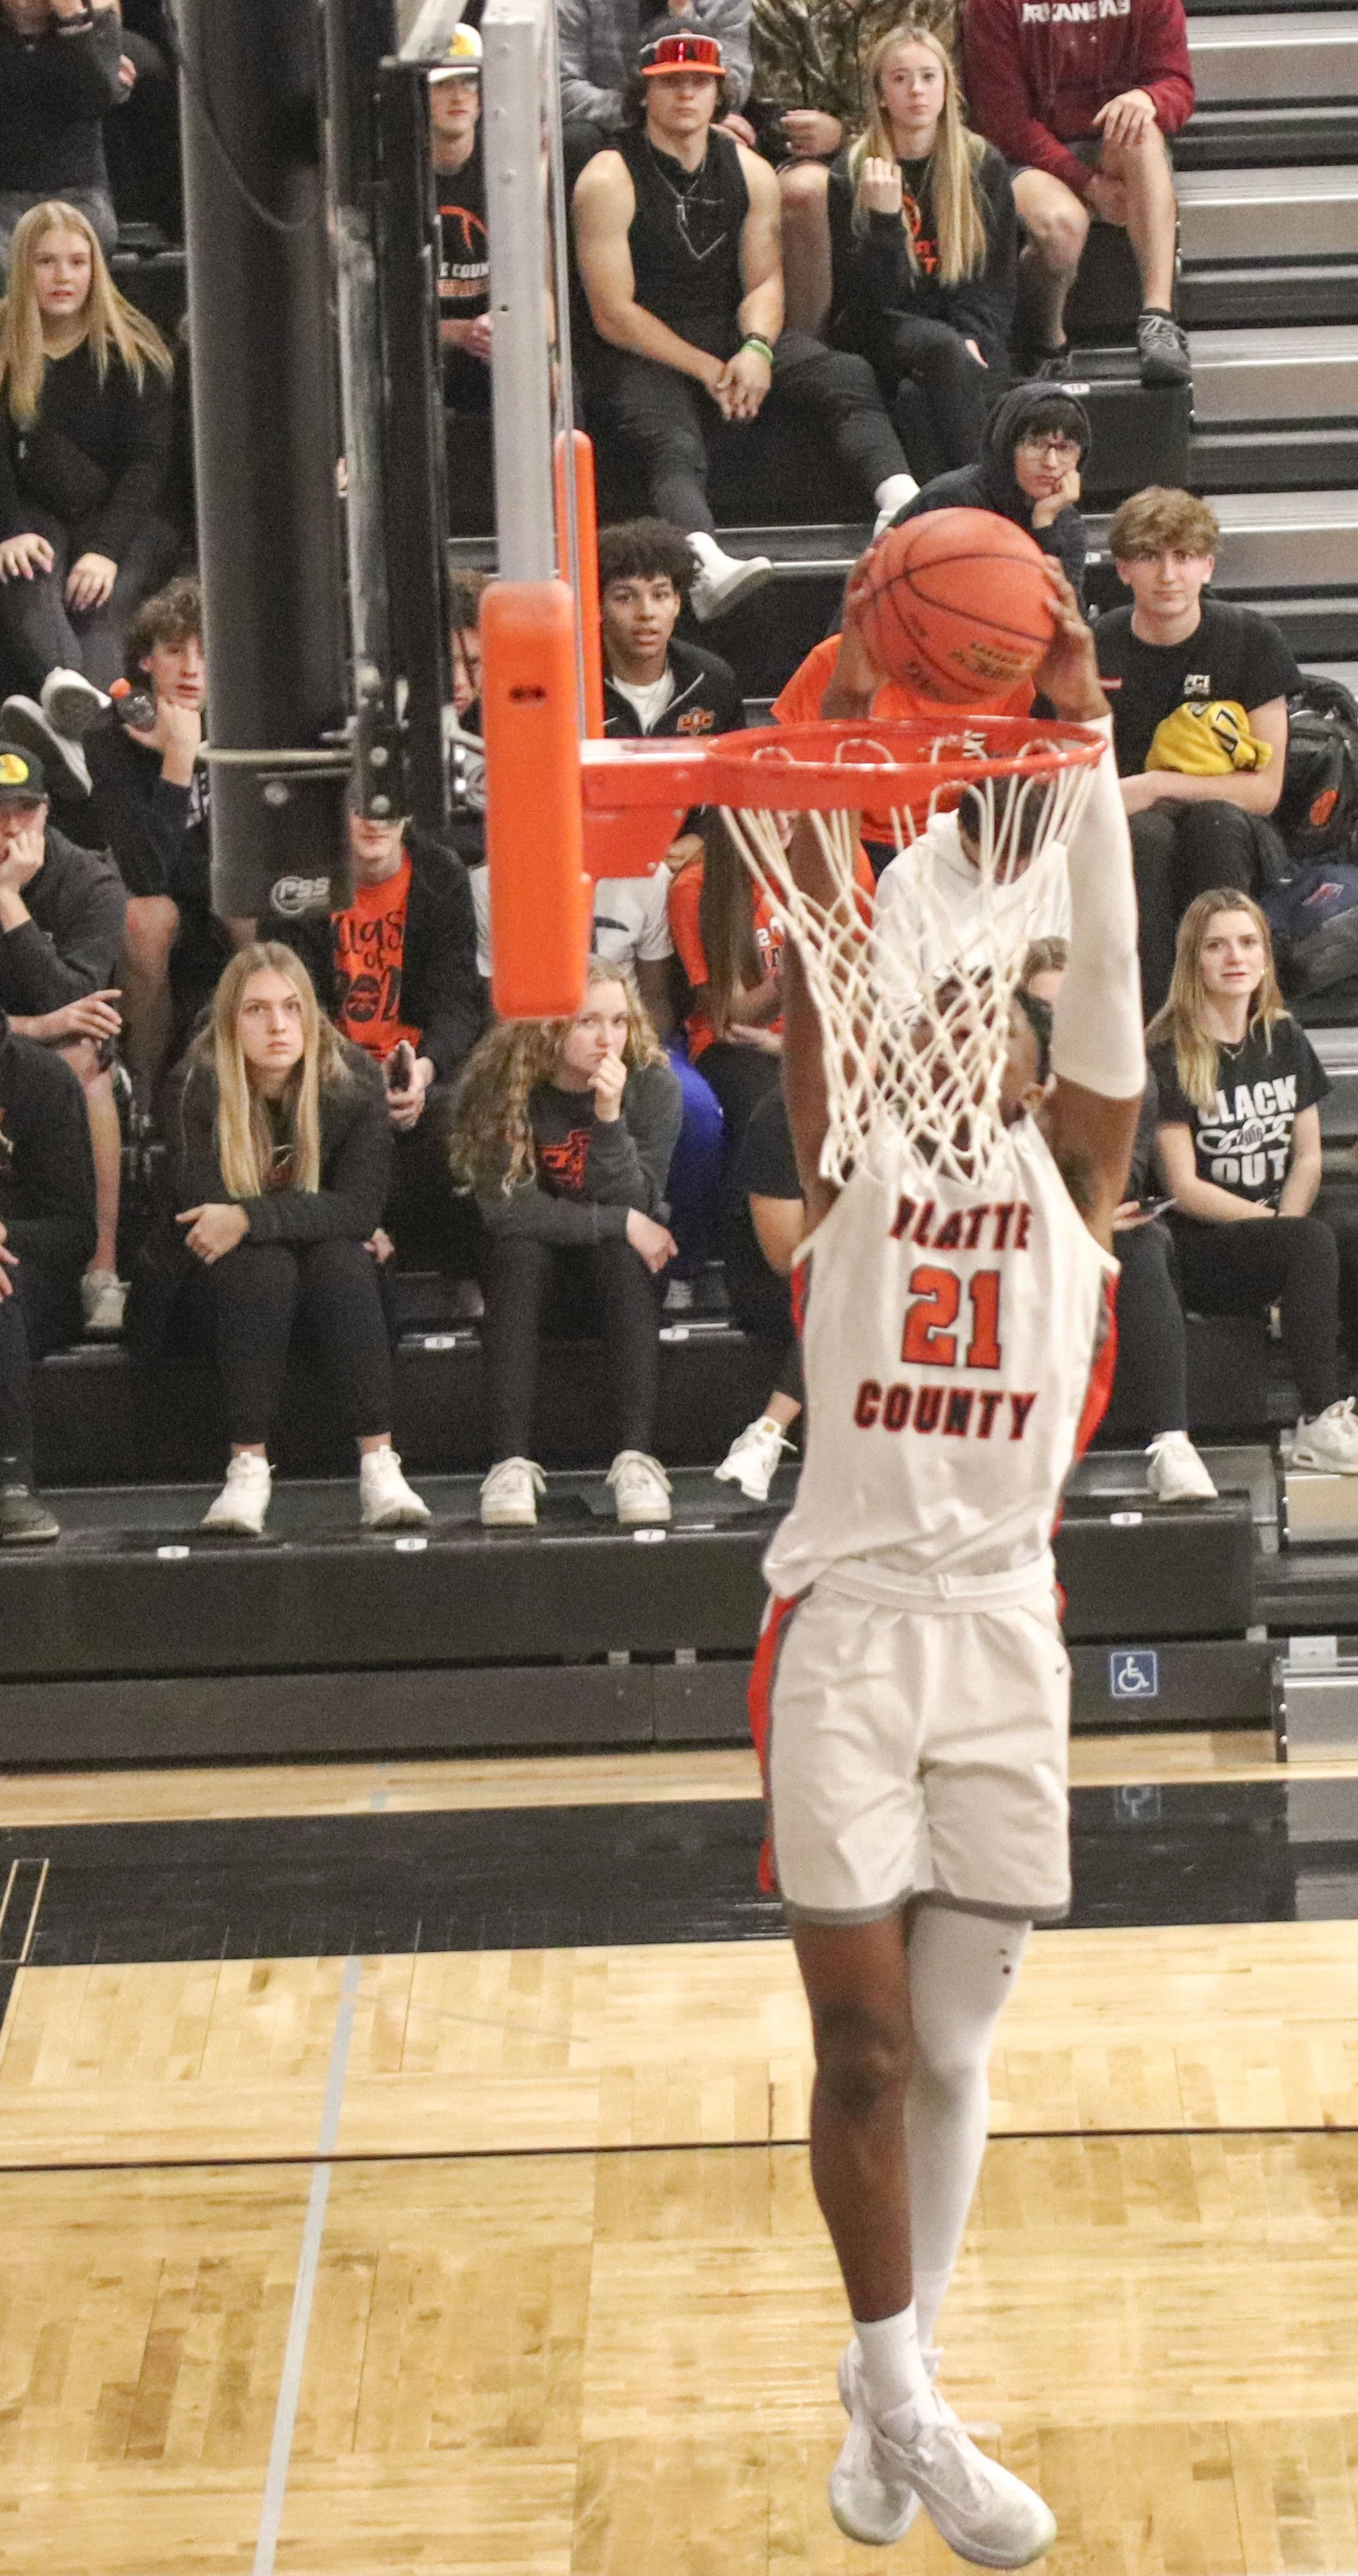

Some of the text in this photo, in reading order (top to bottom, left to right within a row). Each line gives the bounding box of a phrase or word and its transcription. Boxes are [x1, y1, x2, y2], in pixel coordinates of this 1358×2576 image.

[1211, 1146, 1288, 1186] OUT
[889, 1194, 1032, 1251] PLATTE
[901, 1264, 1001, 1370] 21
[854, 1378, 1038, 1441] COUNTY
